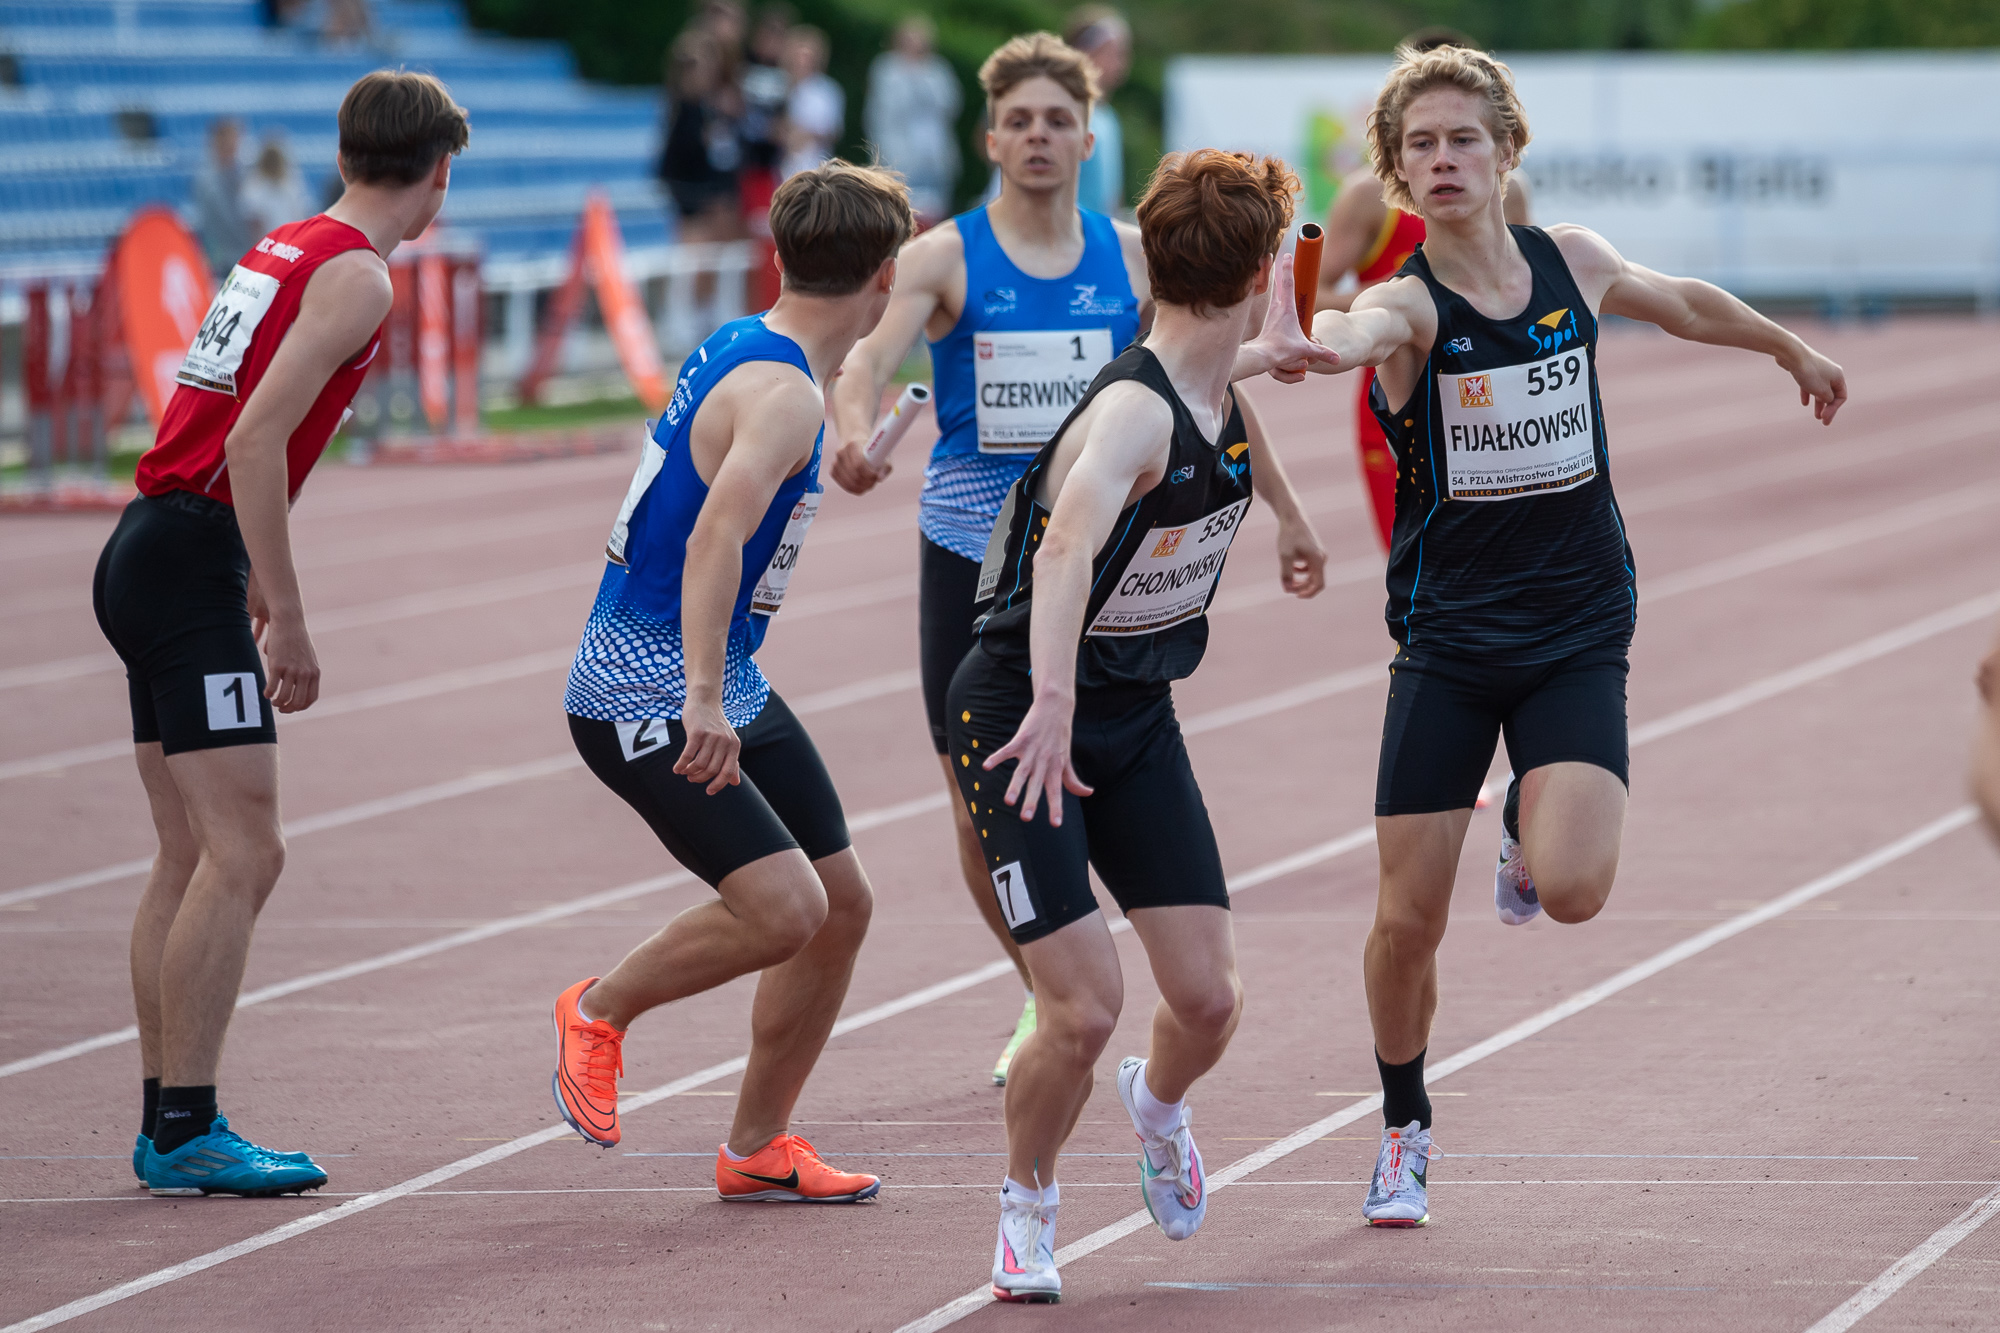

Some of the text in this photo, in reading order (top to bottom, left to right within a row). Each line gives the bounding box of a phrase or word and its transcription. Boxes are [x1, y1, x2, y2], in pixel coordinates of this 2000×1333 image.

[1069, 336, 1086, 361] 1
[1527, 310, 1579, 356] Sopot
[981, 374, 1092, 408] CZERWIŃS
[1527, 355, 1581, 396] 559
[1462, 396, 1492, 406] PZLA
[1450, 403, 1588, 452] FIJAŁKOWSKI
[1452, 454, 1594, 486] 54. PZLA Mistrzostwa Polski U18
[1455, 486, 1525, 497] BIELSKO-BIAŁA
[1198, 504, 1240, 544] 558
[1119, 547, 1226, 597] CHOJNOWSKI
[1097, 615, 1110, 623] 54.
[1112, 615, 1133, 623] PZLA
[1133, 609, 1175, 623] Mistrzostwa
[223, 677, 246, 723] 1
[632, 719, 658, 753] 2
[996, 870, 1017, 922] 7
